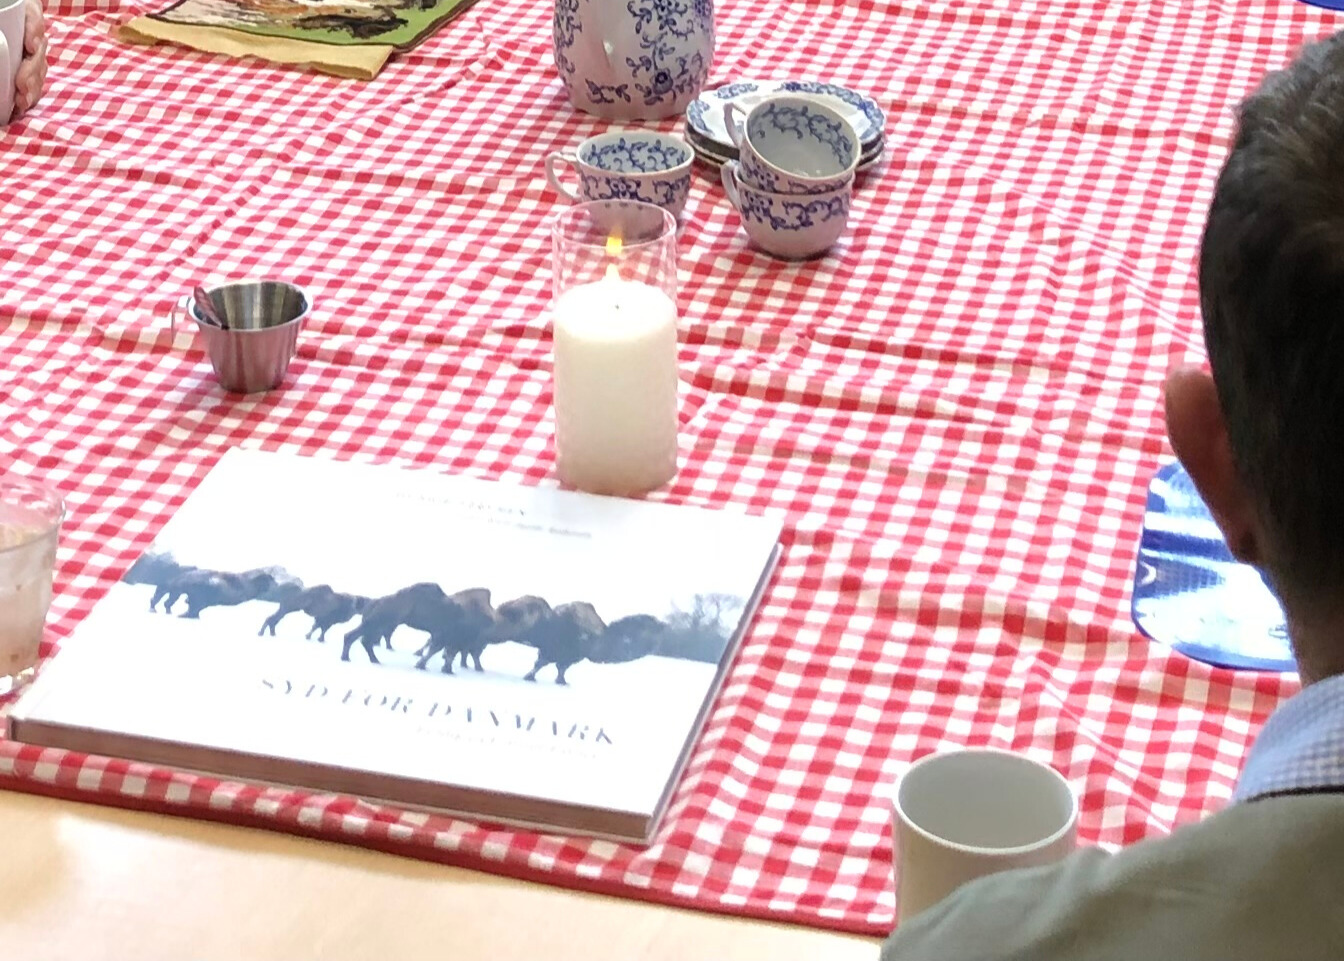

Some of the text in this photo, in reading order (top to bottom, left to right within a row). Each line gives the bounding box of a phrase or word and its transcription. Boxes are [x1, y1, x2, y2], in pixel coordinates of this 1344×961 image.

[262, 678, 328, 699] SYD
[342, 689, 414, 714] FOR
[428, 702, 612, 745] DANMARK
